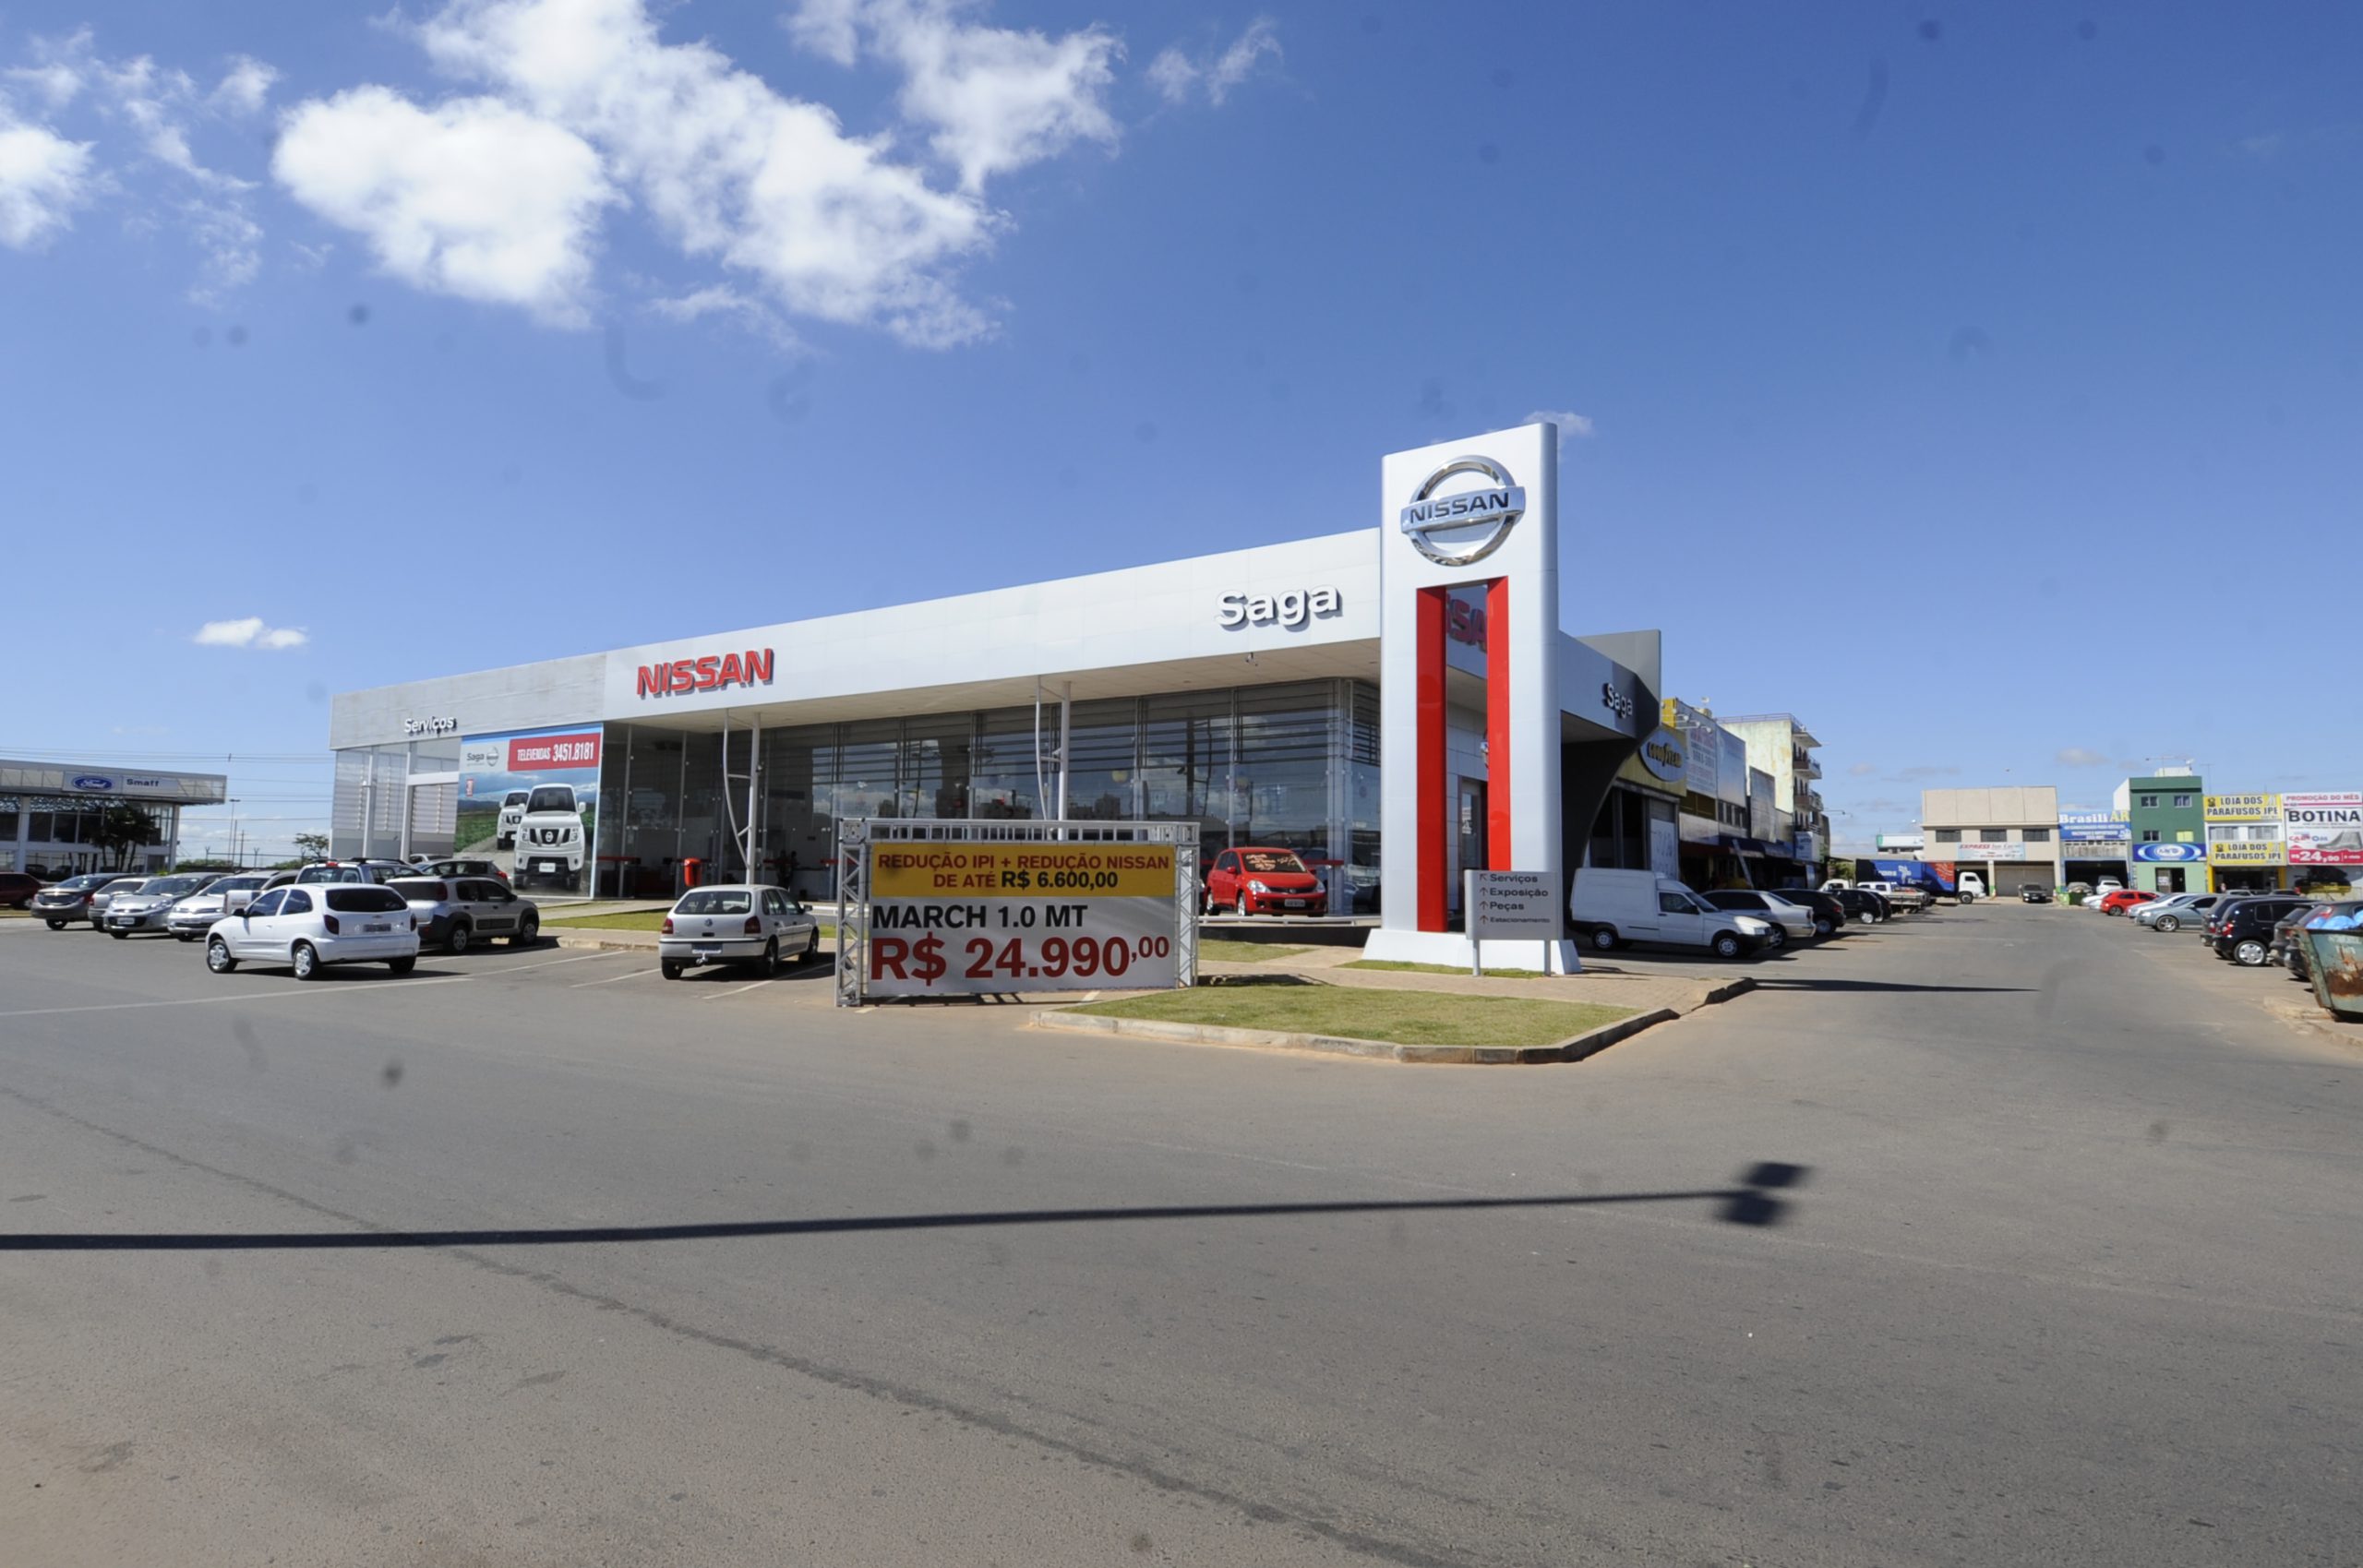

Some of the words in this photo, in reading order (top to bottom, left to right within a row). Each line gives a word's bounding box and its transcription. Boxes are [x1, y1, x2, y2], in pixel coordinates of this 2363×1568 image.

[1409, 492, 1509, 524] NISSAN
[1215, 584, 1339, 627] Saga
[637, 648, 774, 696] NISSAN
[1606, 682, 1633, 719] Saga
[466, 752, 485, 762] Saga
[517, 748, 551, 761] TELEVENDAS
[553, 741, 594, 761] 3451.8181
[2244, 796, 2262, 806] DOS
[2207, 807, 2261, 816] PARAFUSOS
[2288, 810, 2361, 823] BOTINA
[2249, 843, 2268, 851] DOS
[879, 852, 967, 871] REDUÇÃO
[973, 855, 995, 869] IPI
[1017, 852, 1102, 872] REDUÇÃO
[1107, 856, 1170, 869] NISSAN
[2215, 852, 2266, 860] PARAFUSOS
[933, 873, 958, 888] DE
[963, 871, 997, 888] ATÉ
[1002, 869, 1031, 891] R$
[1037, 870, 1119, 891] 6.600,00
[1489, 873, 1539, 884] Serviços
[1489, 887, 1549, 898] Exposição
[1489, 901, 1525, 911] Peças
[871, 904, 987, 929] MARCH
[998, 905, 1036, 928] 1.0
[1046, 904, 1088, 927] MT
[870, 931, 947, 987] R$
[965, 935, 1170, 979] 24.990,00
